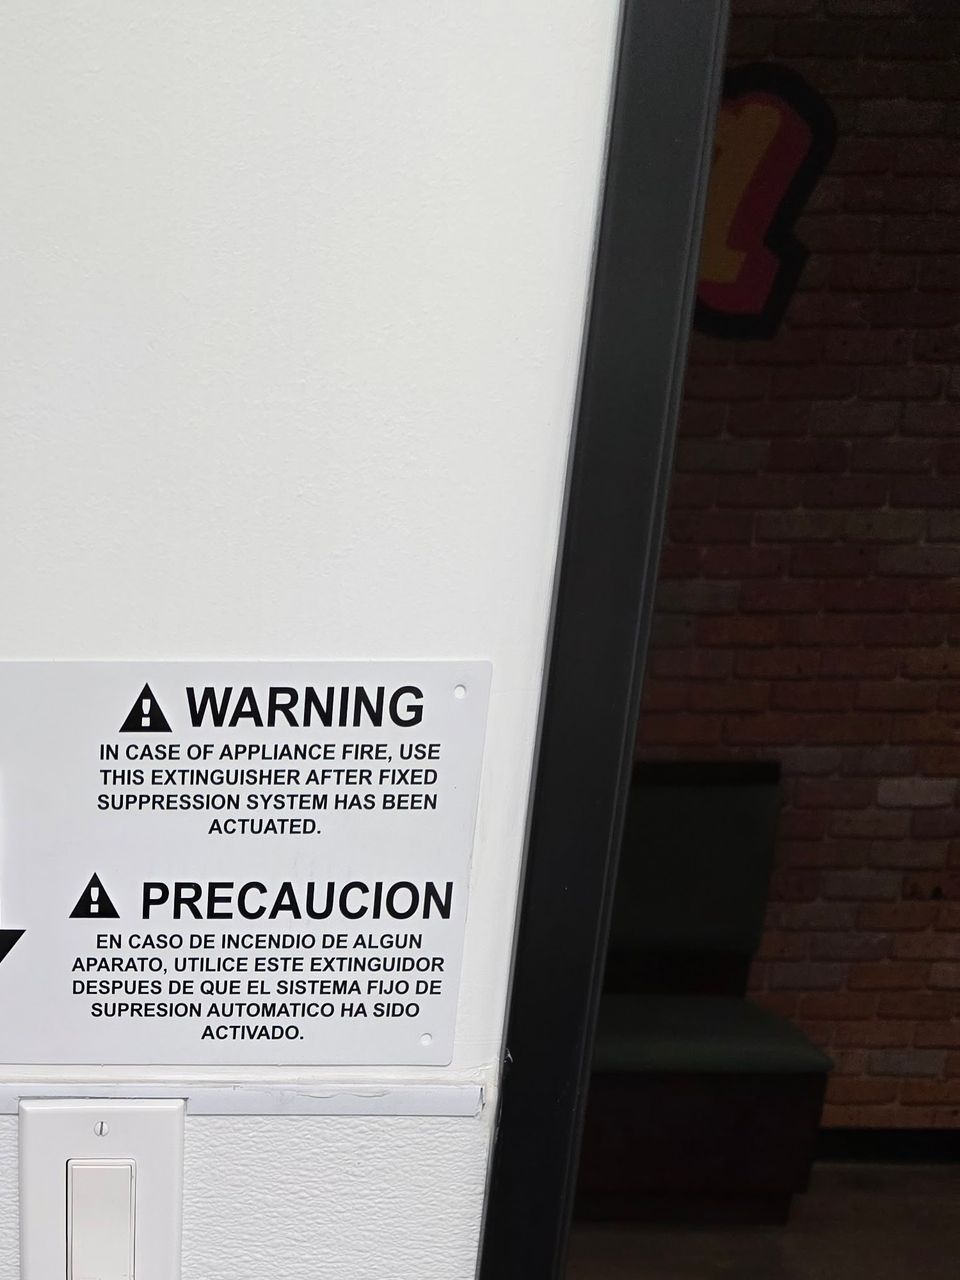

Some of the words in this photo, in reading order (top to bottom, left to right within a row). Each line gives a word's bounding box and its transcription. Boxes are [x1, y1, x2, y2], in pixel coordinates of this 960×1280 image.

[185, 685, 425, 728] WARNING
[99, 743, 119, 760] IN
[125, 743, 181, 761] CASE
[186, 743, 214, 761] OF
[219, 743, 336, 761] APPLIANCE
[341, 743, 393, 763] FIRE,
[399, 743, 441, 760] USE
[100, 769, 145, 786] THIS
[151, 769, 300, 786] EXTINGUISHER
[304, 769, 372, 786] AFTER
[378, 769, 438, 786] FIXED
[97, 793, 240, 811] SUPPRESSION
[246, 793, 328, 811] SYSTEM
[334, 793, 376, 811] HAS
[382, 793, 438, 810] BEEN
[208, 817, 322, 835] ACTUATED.
[141, 881, 454, 920] PRECAUCION
[96, 933, 122, 949] EN
[128, 933, 183, 949] CASO
[189, 933, 215, 949] DE
[221, 933, 316, 949] INCENDIO
[321, 933, 348, 949] DE
[352, 933, 423, 949] ALGUN
[71, 956, 168, 975] APARATO,
[174, 956, 248, 972] UTILICE
[254, 956, 304, 972] ESTE
[310, 956, 445, 972] EXTINGUIDOR
[72, 979, 162, 995] DESPUES
[168, 979, 194, 995] DE
[200, 979, 241, 996] QUE
[246, 979, 271, 995] EL
[276, 979, 362, 995] SISTEMA
[367, 979, 409, 995] FIJO
[414, 979, 442, 995] DE
[91, 1002, 202, 1018] SUPRESION
[206, 1002, 335, 1018] AUTOMATICO
[340, 1002, 368, 1018] HA
[372, 1002, 420, 1018] SIDO
[200, 1024, 304, 1041] ACTIVADO.
